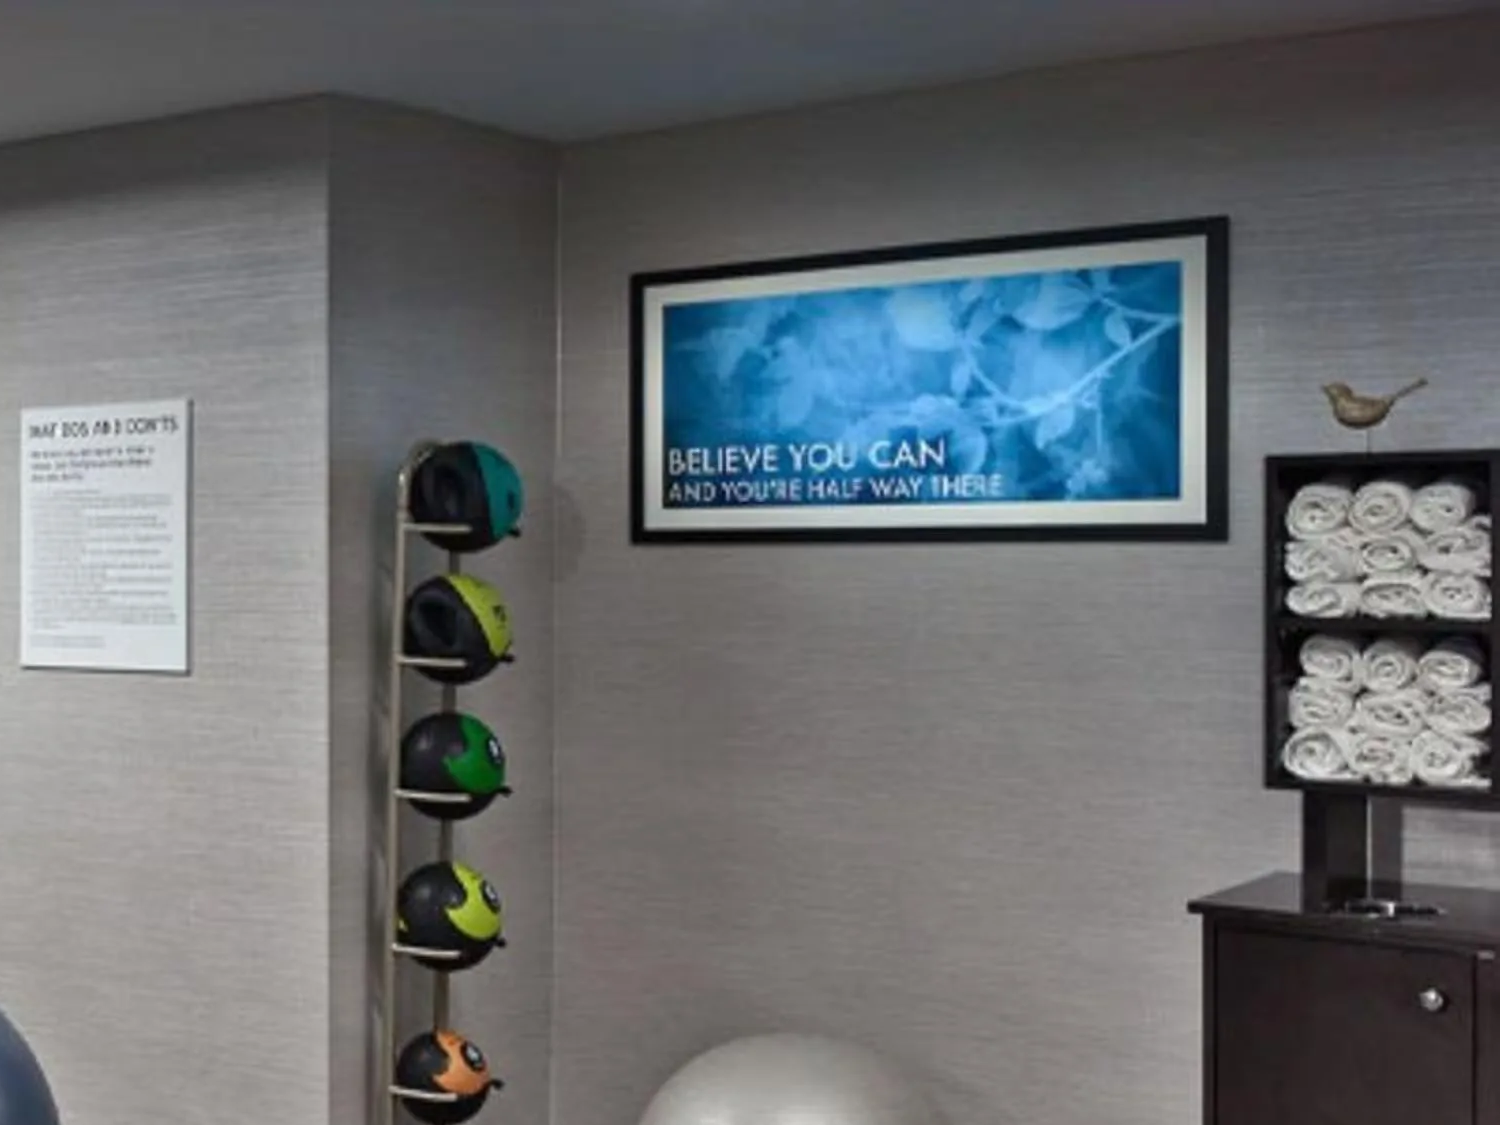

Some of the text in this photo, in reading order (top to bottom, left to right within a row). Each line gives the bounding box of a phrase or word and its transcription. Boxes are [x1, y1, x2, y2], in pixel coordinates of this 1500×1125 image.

[669, 438, 945, 476] BELIEVE YOU CAN
[669, 473, 1005, 502] AND YOU'RE HALF WAY THERE
